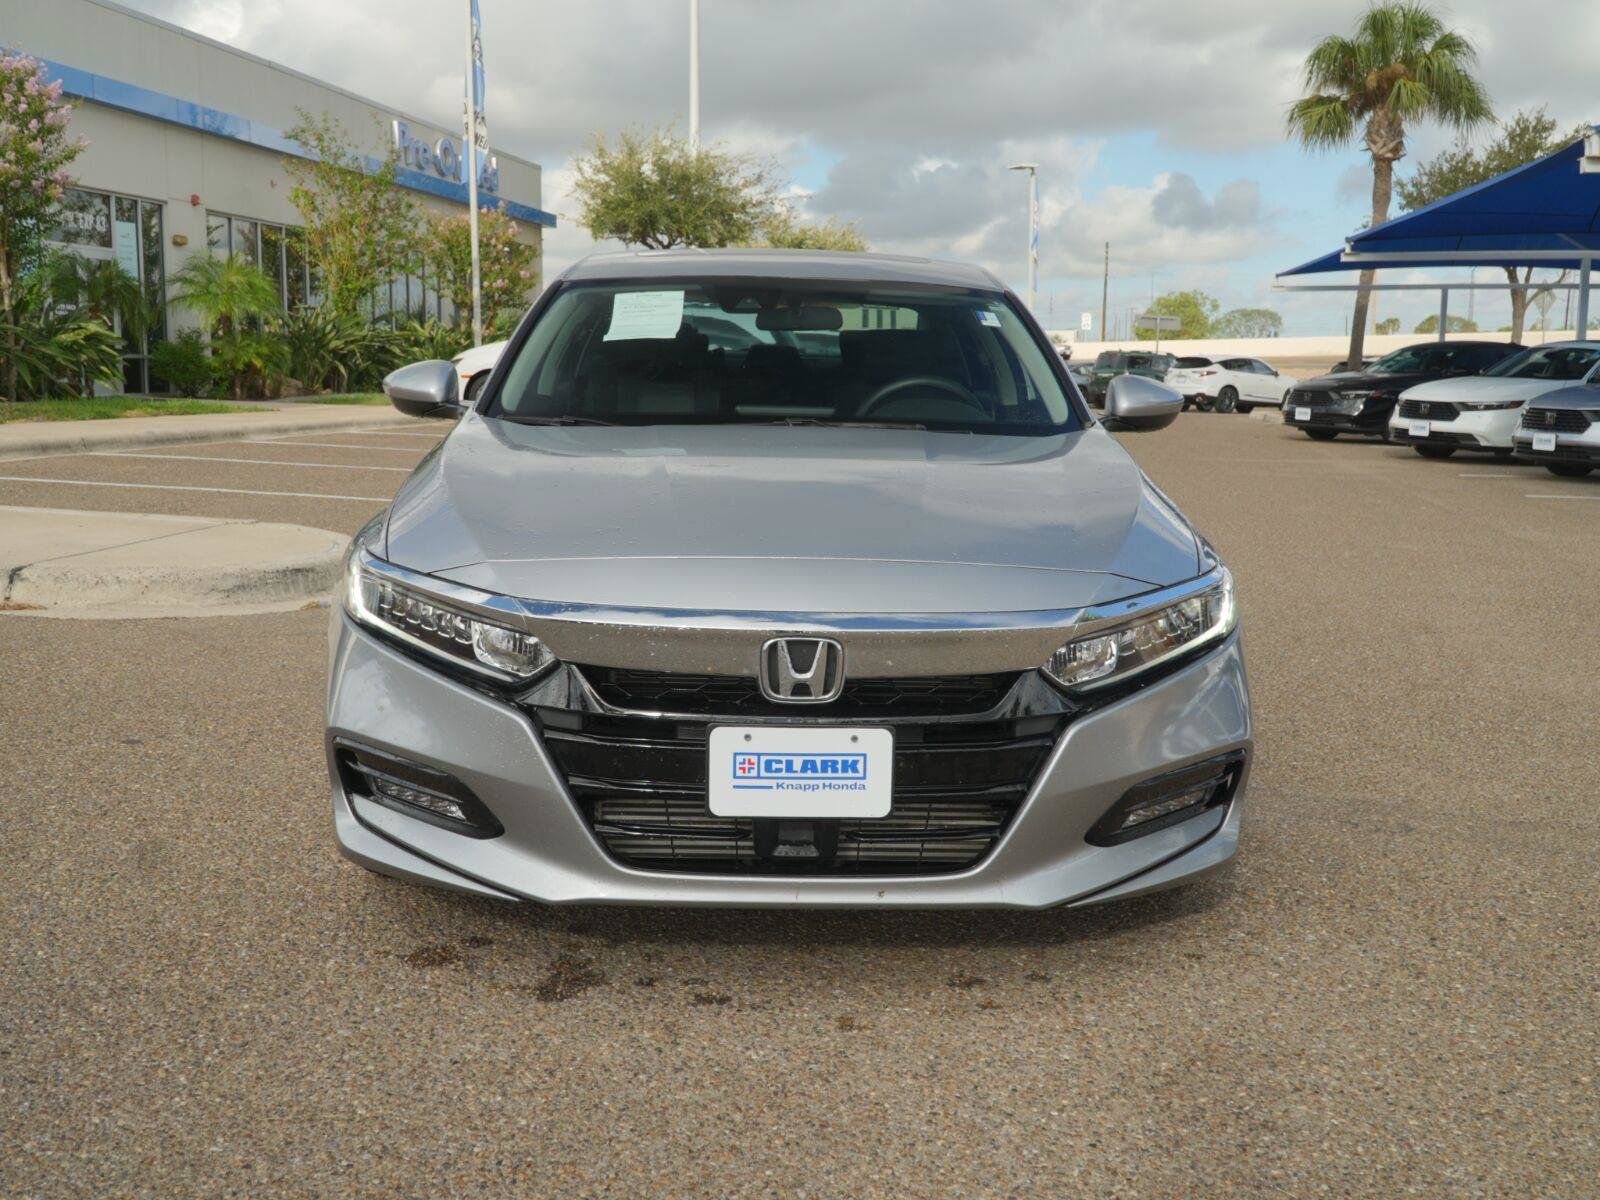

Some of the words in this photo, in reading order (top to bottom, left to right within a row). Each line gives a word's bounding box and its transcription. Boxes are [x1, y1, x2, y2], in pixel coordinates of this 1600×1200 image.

[764, 759, 860, 774] CLARK
[776, 782, 820, 792] Knapp
[822, 782, 866, 791] Honda
